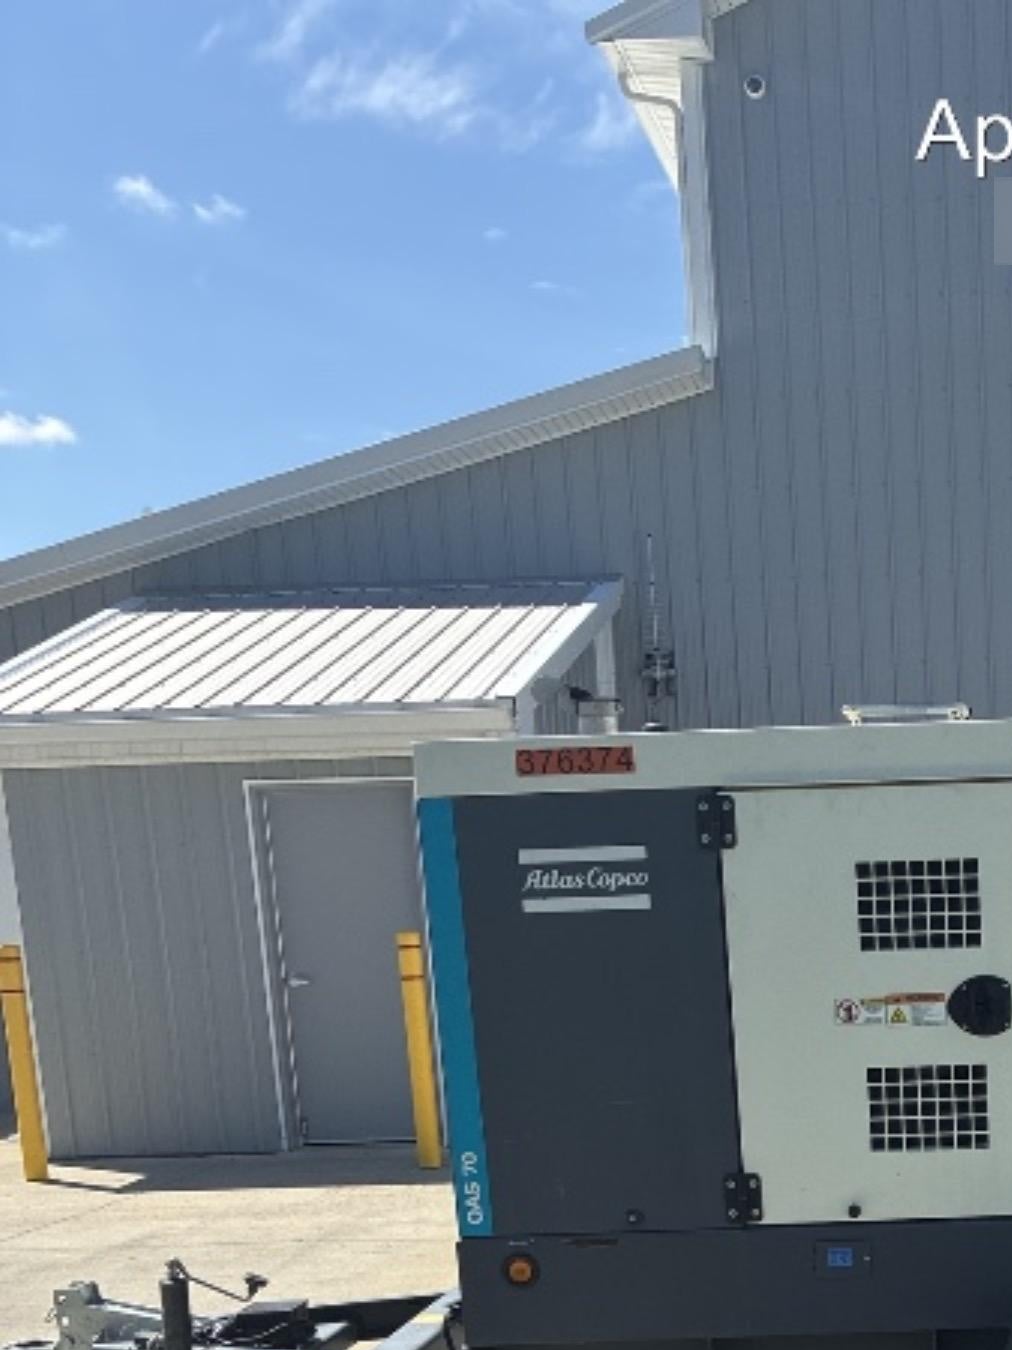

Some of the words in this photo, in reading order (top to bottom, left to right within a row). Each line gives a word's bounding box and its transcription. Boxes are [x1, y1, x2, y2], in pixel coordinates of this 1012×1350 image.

[517, 747, 635, 775] 376374
[522, 869, 585, 892] Atlas
[586, 867, 649, 892] Copco
[461, 1151, 478, 1177] 70
